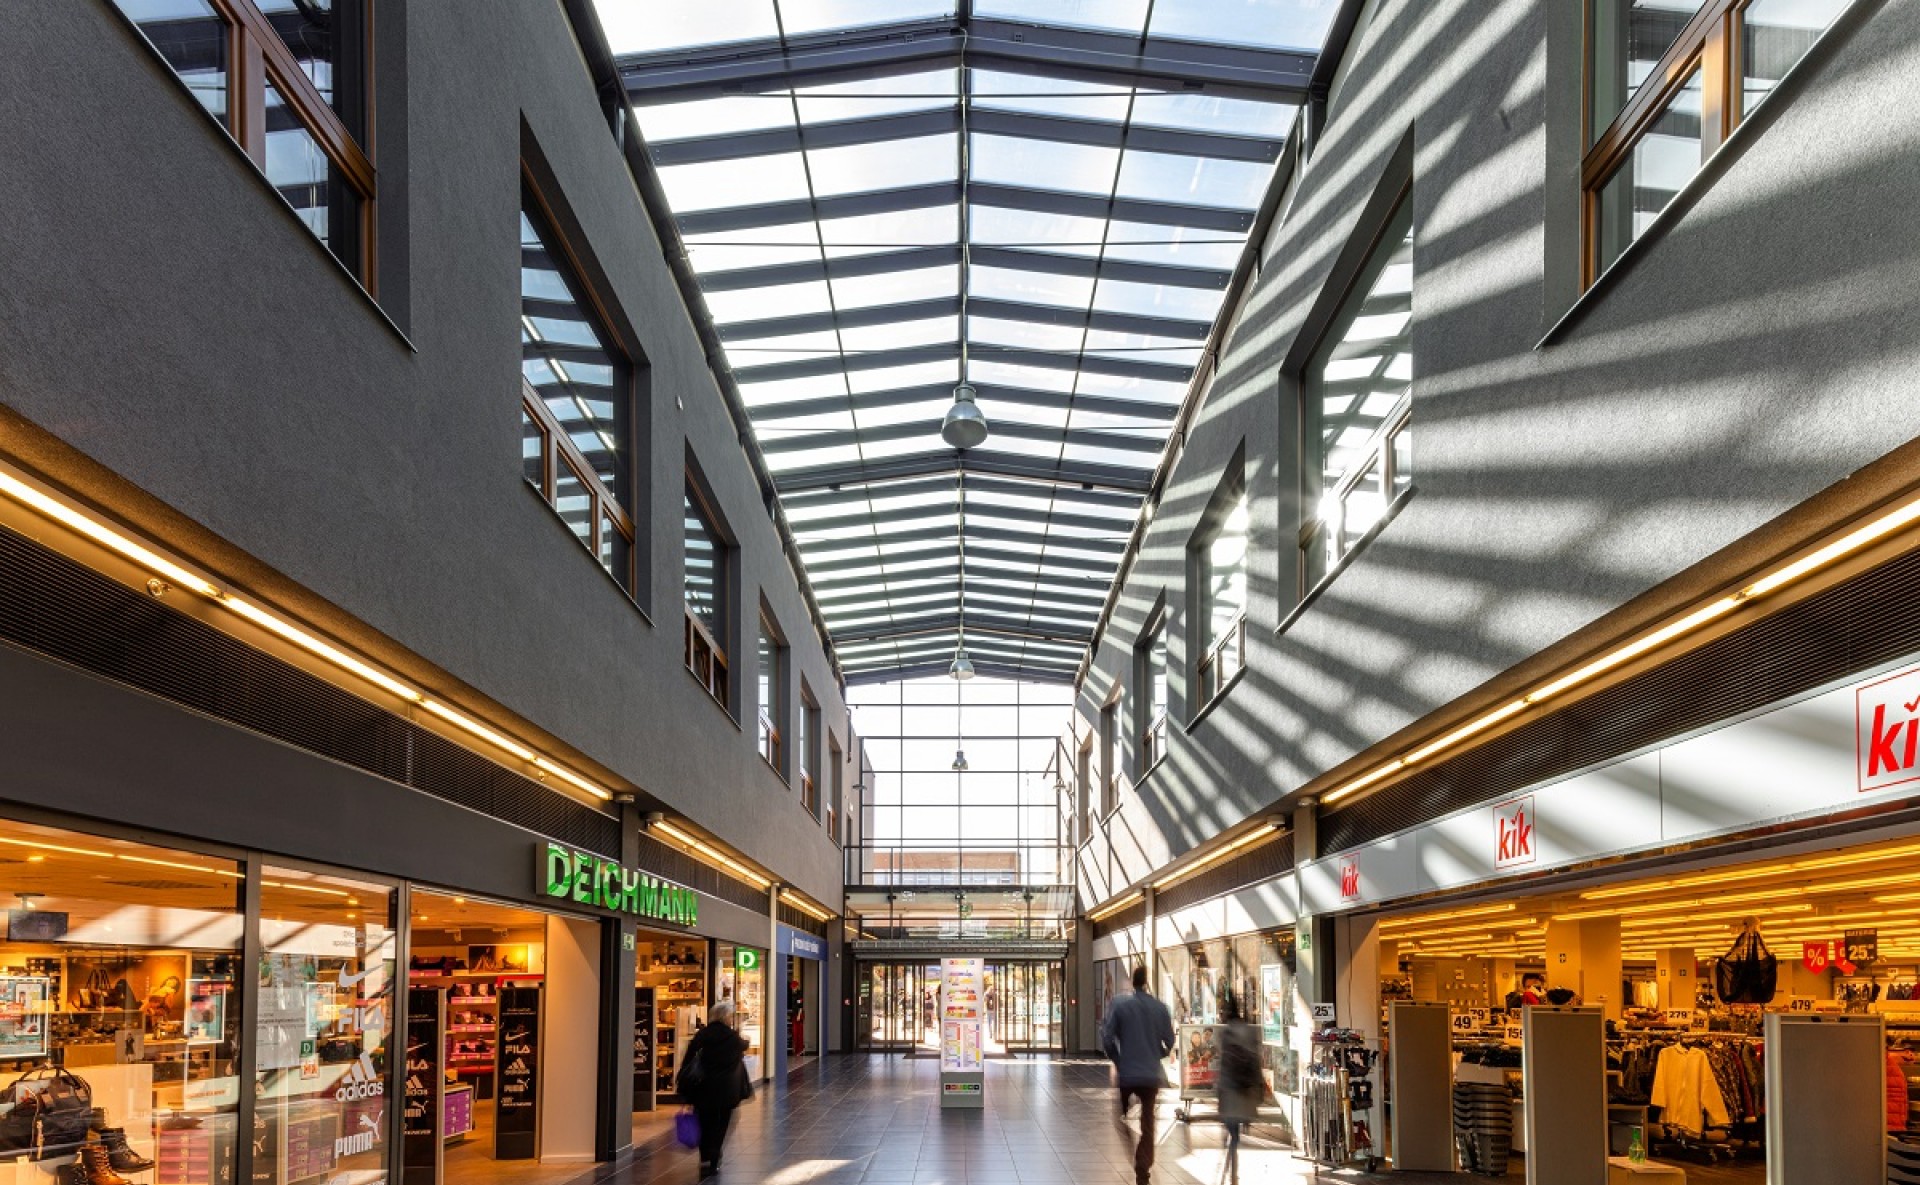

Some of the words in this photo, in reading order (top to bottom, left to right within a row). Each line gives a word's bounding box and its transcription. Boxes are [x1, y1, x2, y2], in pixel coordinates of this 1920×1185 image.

[1499, 804, 1532, 861] kik
[546, 842, 699, 927] DEICHMANN
[1341, 861, 1359, 897] kik
[738, 951, 756, 967] D
[338, 1007, 384, 1033] FILA
[405, 1059, 429, 1070] ILA
[335, 1080, 385, 1102] adidas
[334, 1130, 374, 1159] PUMA
